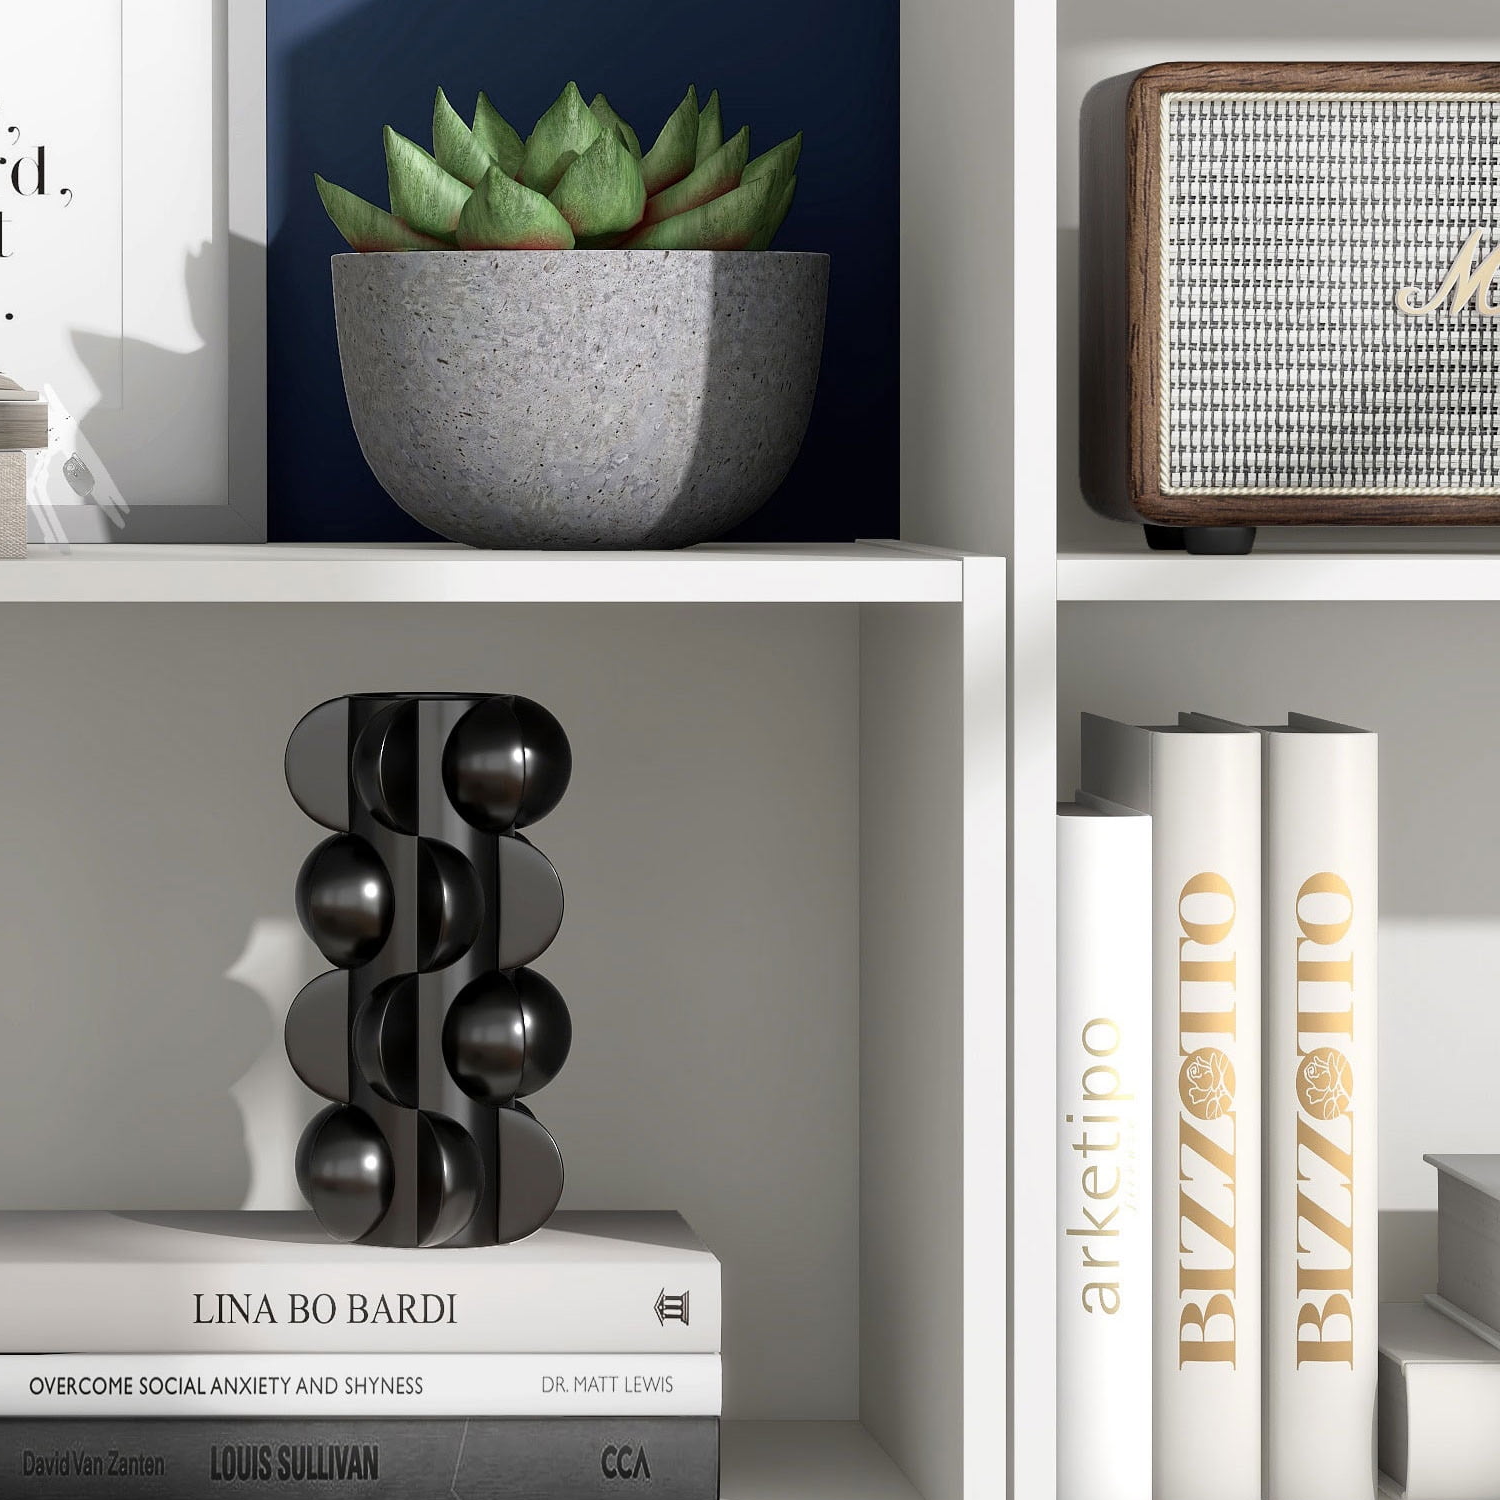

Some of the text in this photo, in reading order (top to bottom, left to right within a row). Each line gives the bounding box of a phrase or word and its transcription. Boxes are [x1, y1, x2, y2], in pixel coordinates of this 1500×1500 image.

[1066, 1017, 1134, 1315] arketipo
[192, 1293, 458, 1325] LINA BO BARDI
[29, 1376, 424, 1396] OVERCOME SOCIAL ANXIETY AND SHYNESS
[542, 1375, 674, 1393] DR. MATT LEWIS
[22, 1450, 165, 1477] David Van Zanten
[210, 1445, 379, 1481] LOUIS SULLIVAN
[601, 1445, 651, 1480] CCA
